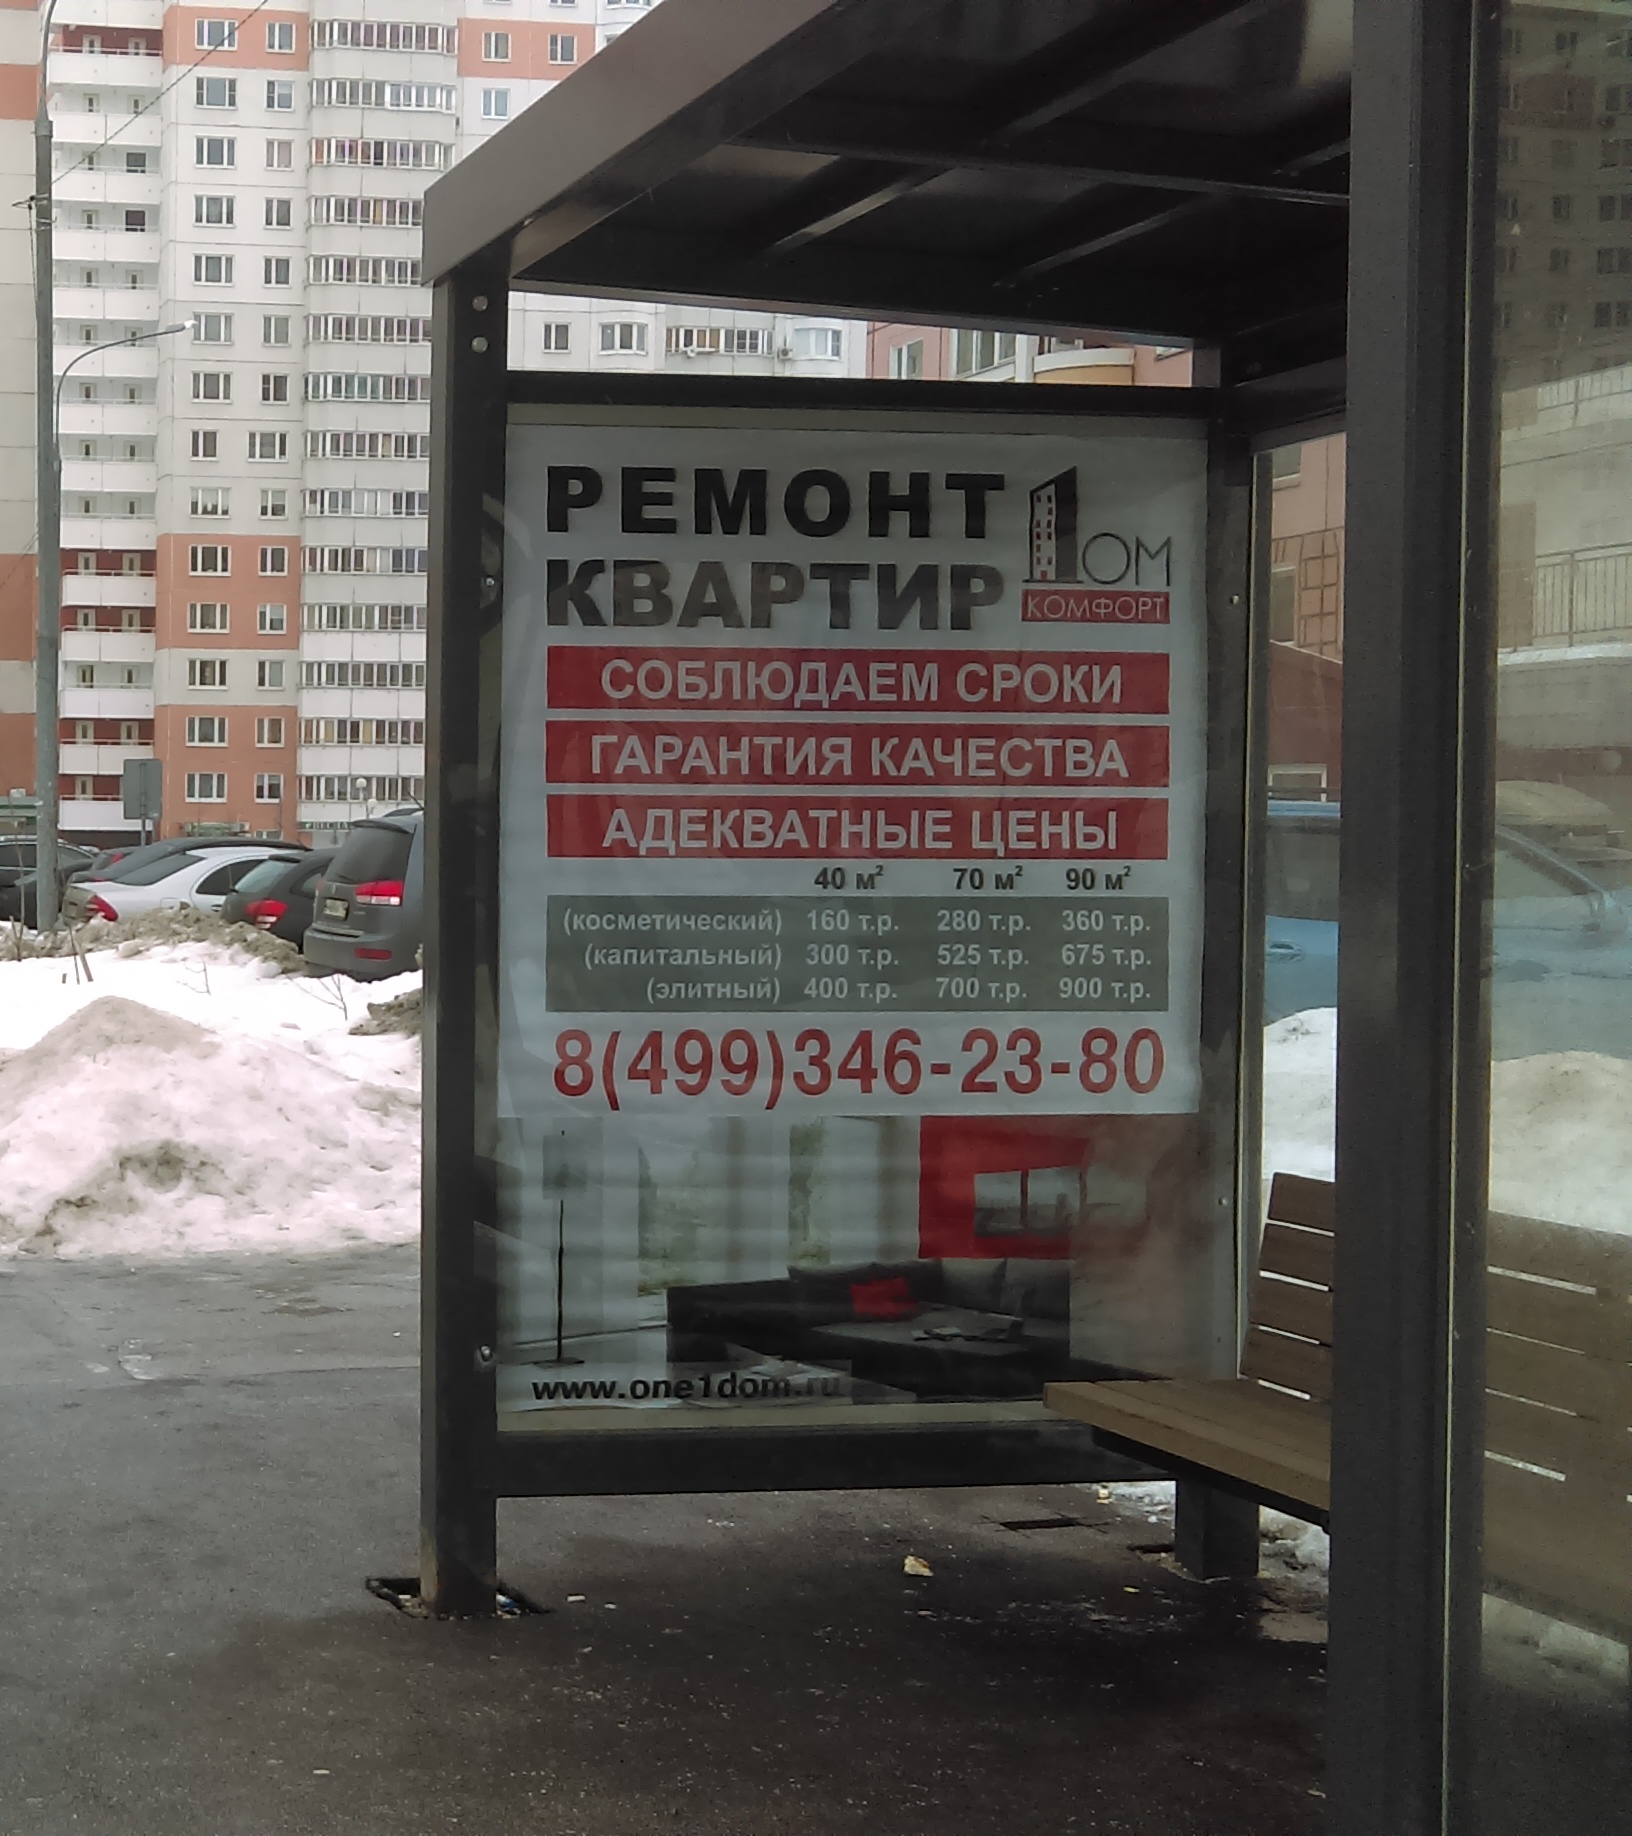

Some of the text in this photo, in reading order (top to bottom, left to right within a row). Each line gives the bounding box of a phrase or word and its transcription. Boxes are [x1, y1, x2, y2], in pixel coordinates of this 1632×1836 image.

[546, 465, 1005, 540] РЕМОНТ
[546, 559, 1005, 631] КВАРТИР
[1027, 594, 1165, 620] КОМФОРТ
[600, 658, 1123, 709] СОБЛЮДАЕМ СРОКИ
[590, 735, 1130, 779] ГАРАНТИЯ КАЧЕСТВА
[601, 809, 1118, 856] АДЕКВАТНЫЕ ЦЕНЫ
[813, 867, 846, 891] 40
[953, 867, 984, 891] 70
[1065, 867, 1096, 891] 90
[563, 908, 1151, 938] (косметический) 160 т.р. 280 т.р. 360 т.р.
[584, 942, 1152, 971] (капитальный) 300 т.р. 525 т.р. 675 т.р.
[646, 976, 1151, 1004] (элитный) 400 т.р. 700 т.р. 900 т.р.
[553, 1027, 1165, 1110] 8(499)346-23-80
[531, 1372, 842, 1400] www.one1dom.ru
